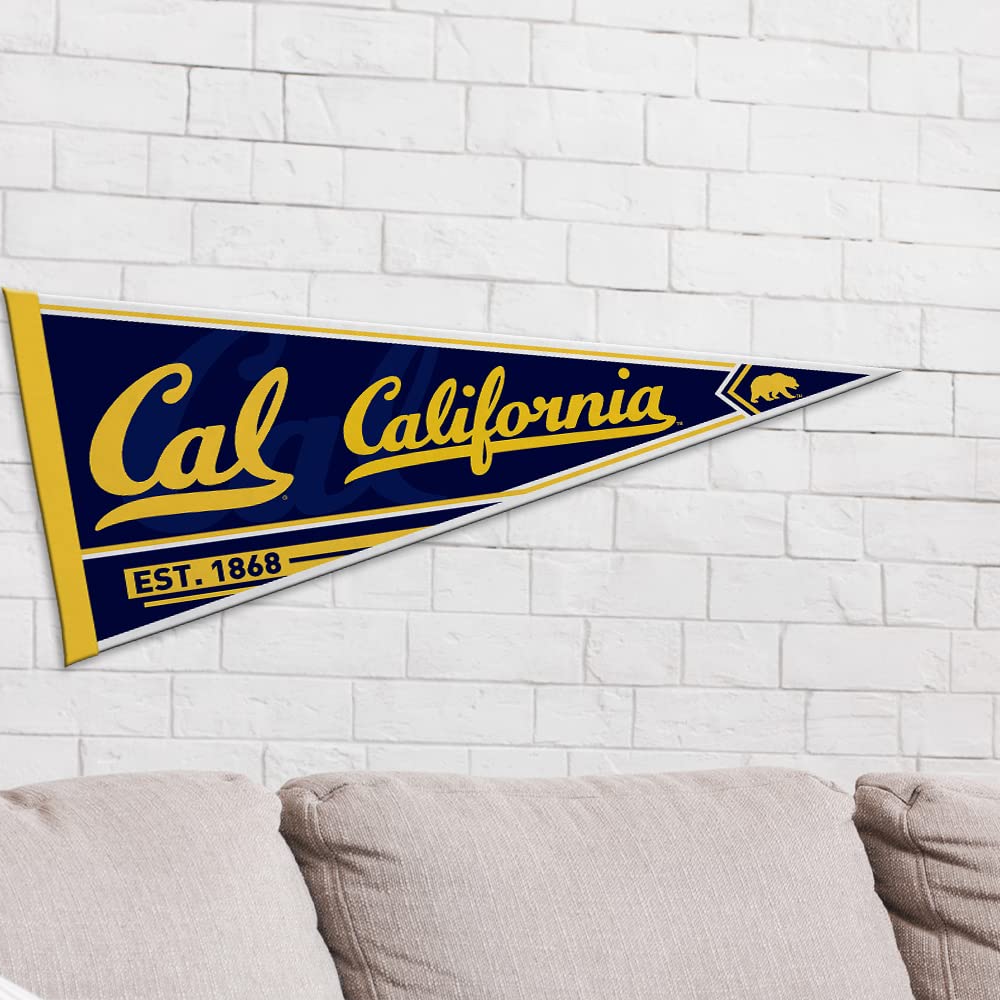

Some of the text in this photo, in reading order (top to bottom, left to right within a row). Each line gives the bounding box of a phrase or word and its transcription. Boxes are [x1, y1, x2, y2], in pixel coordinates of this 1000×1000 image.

[89, 362, 294, 531] Cal
[344, 365, 677, 485] California
[133, 551, 282, 594] EST. 1868
